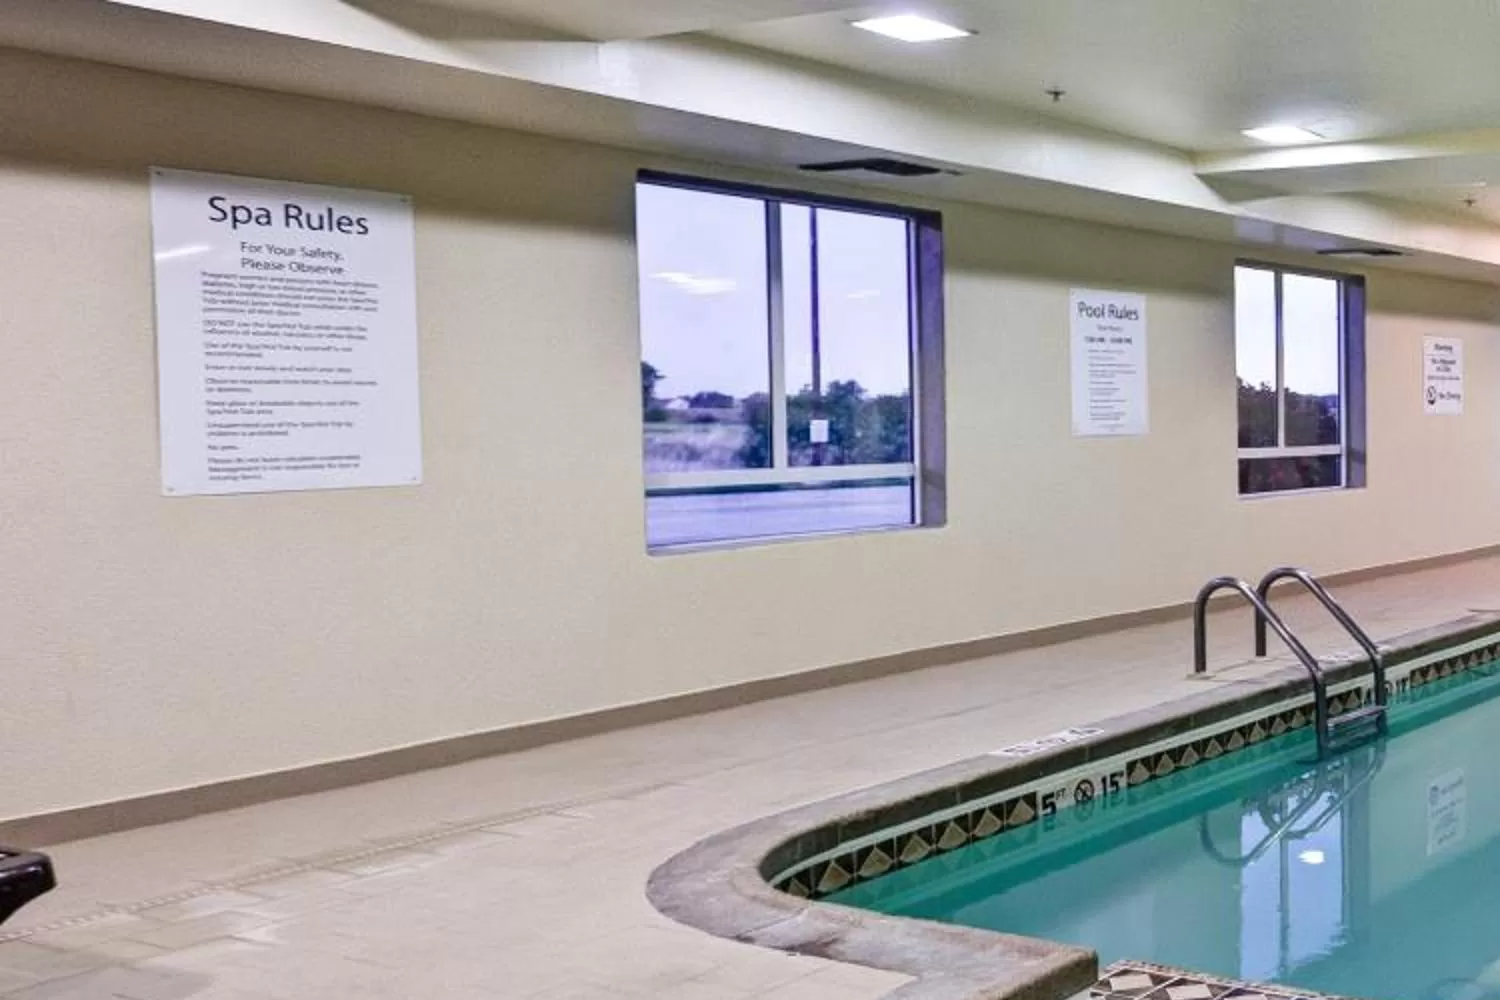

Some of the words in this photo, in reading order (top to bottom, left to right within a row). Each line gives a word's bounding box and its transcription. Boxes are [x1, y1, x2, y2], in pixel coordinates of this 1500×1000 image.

[208, 195, 272, 229] Spa
[284, 203, 369, 235] Rules
[240, 242, 263, 253] For
[267, 244, 297, 257] Your
[241, 257, 285, 271] Please
[1077, 301, 1105, 319] Pool
[1108, 304, 1139, 320] Rules
[1042, 792, 1056, 817] 5
